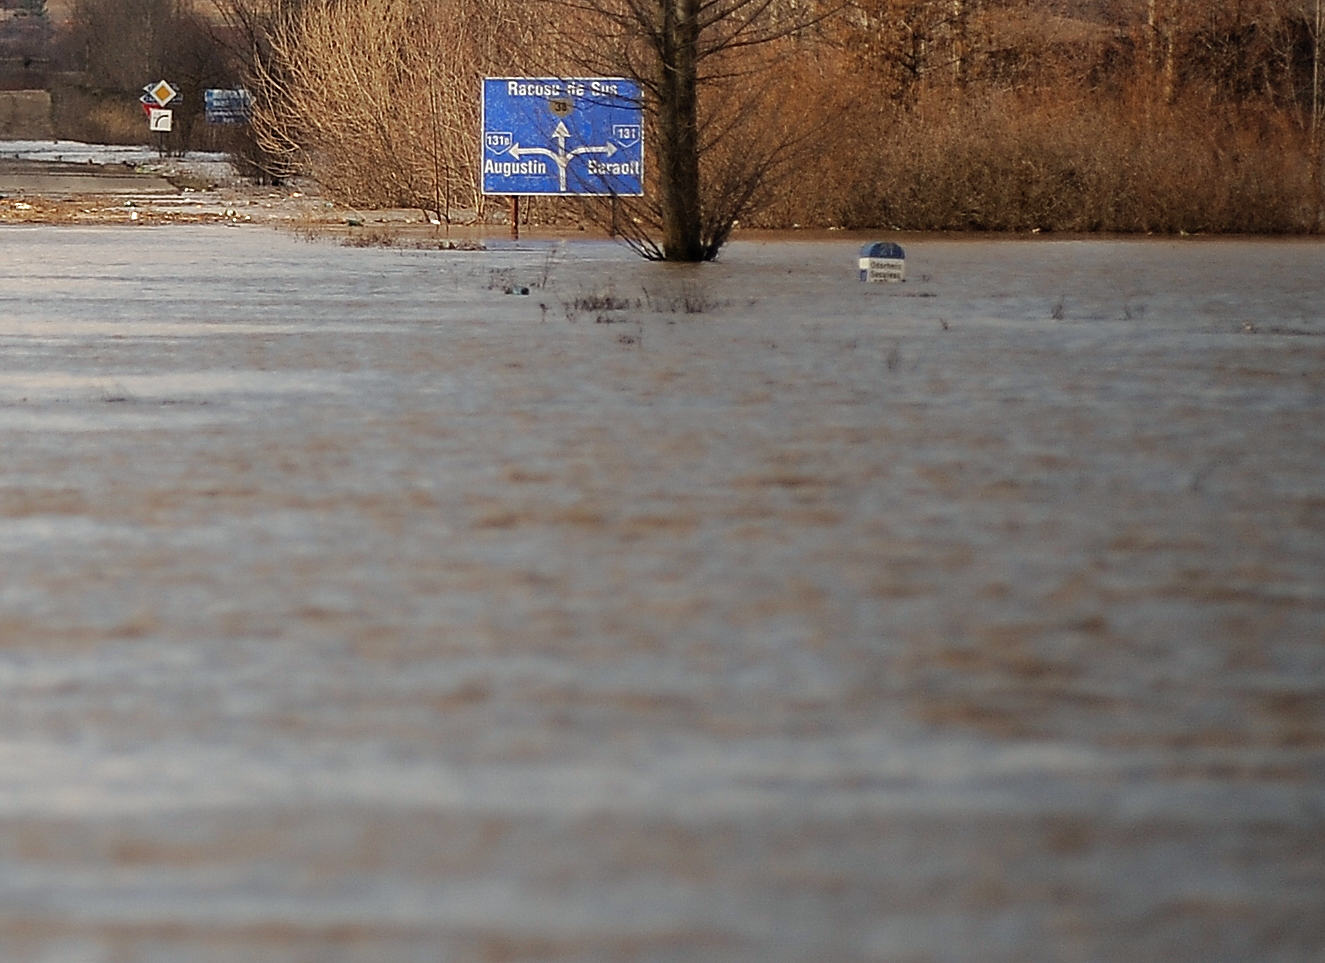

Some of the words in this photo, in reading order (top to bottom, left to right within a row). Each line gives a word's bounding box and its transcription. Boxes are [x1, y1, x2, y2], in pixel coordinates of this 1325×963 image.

[567, 82, 585, 96] de
[591, 81, 618, 96] Sus
[618, 128, 636, 139] 131
[484, 159, 546, 177] Augustin
